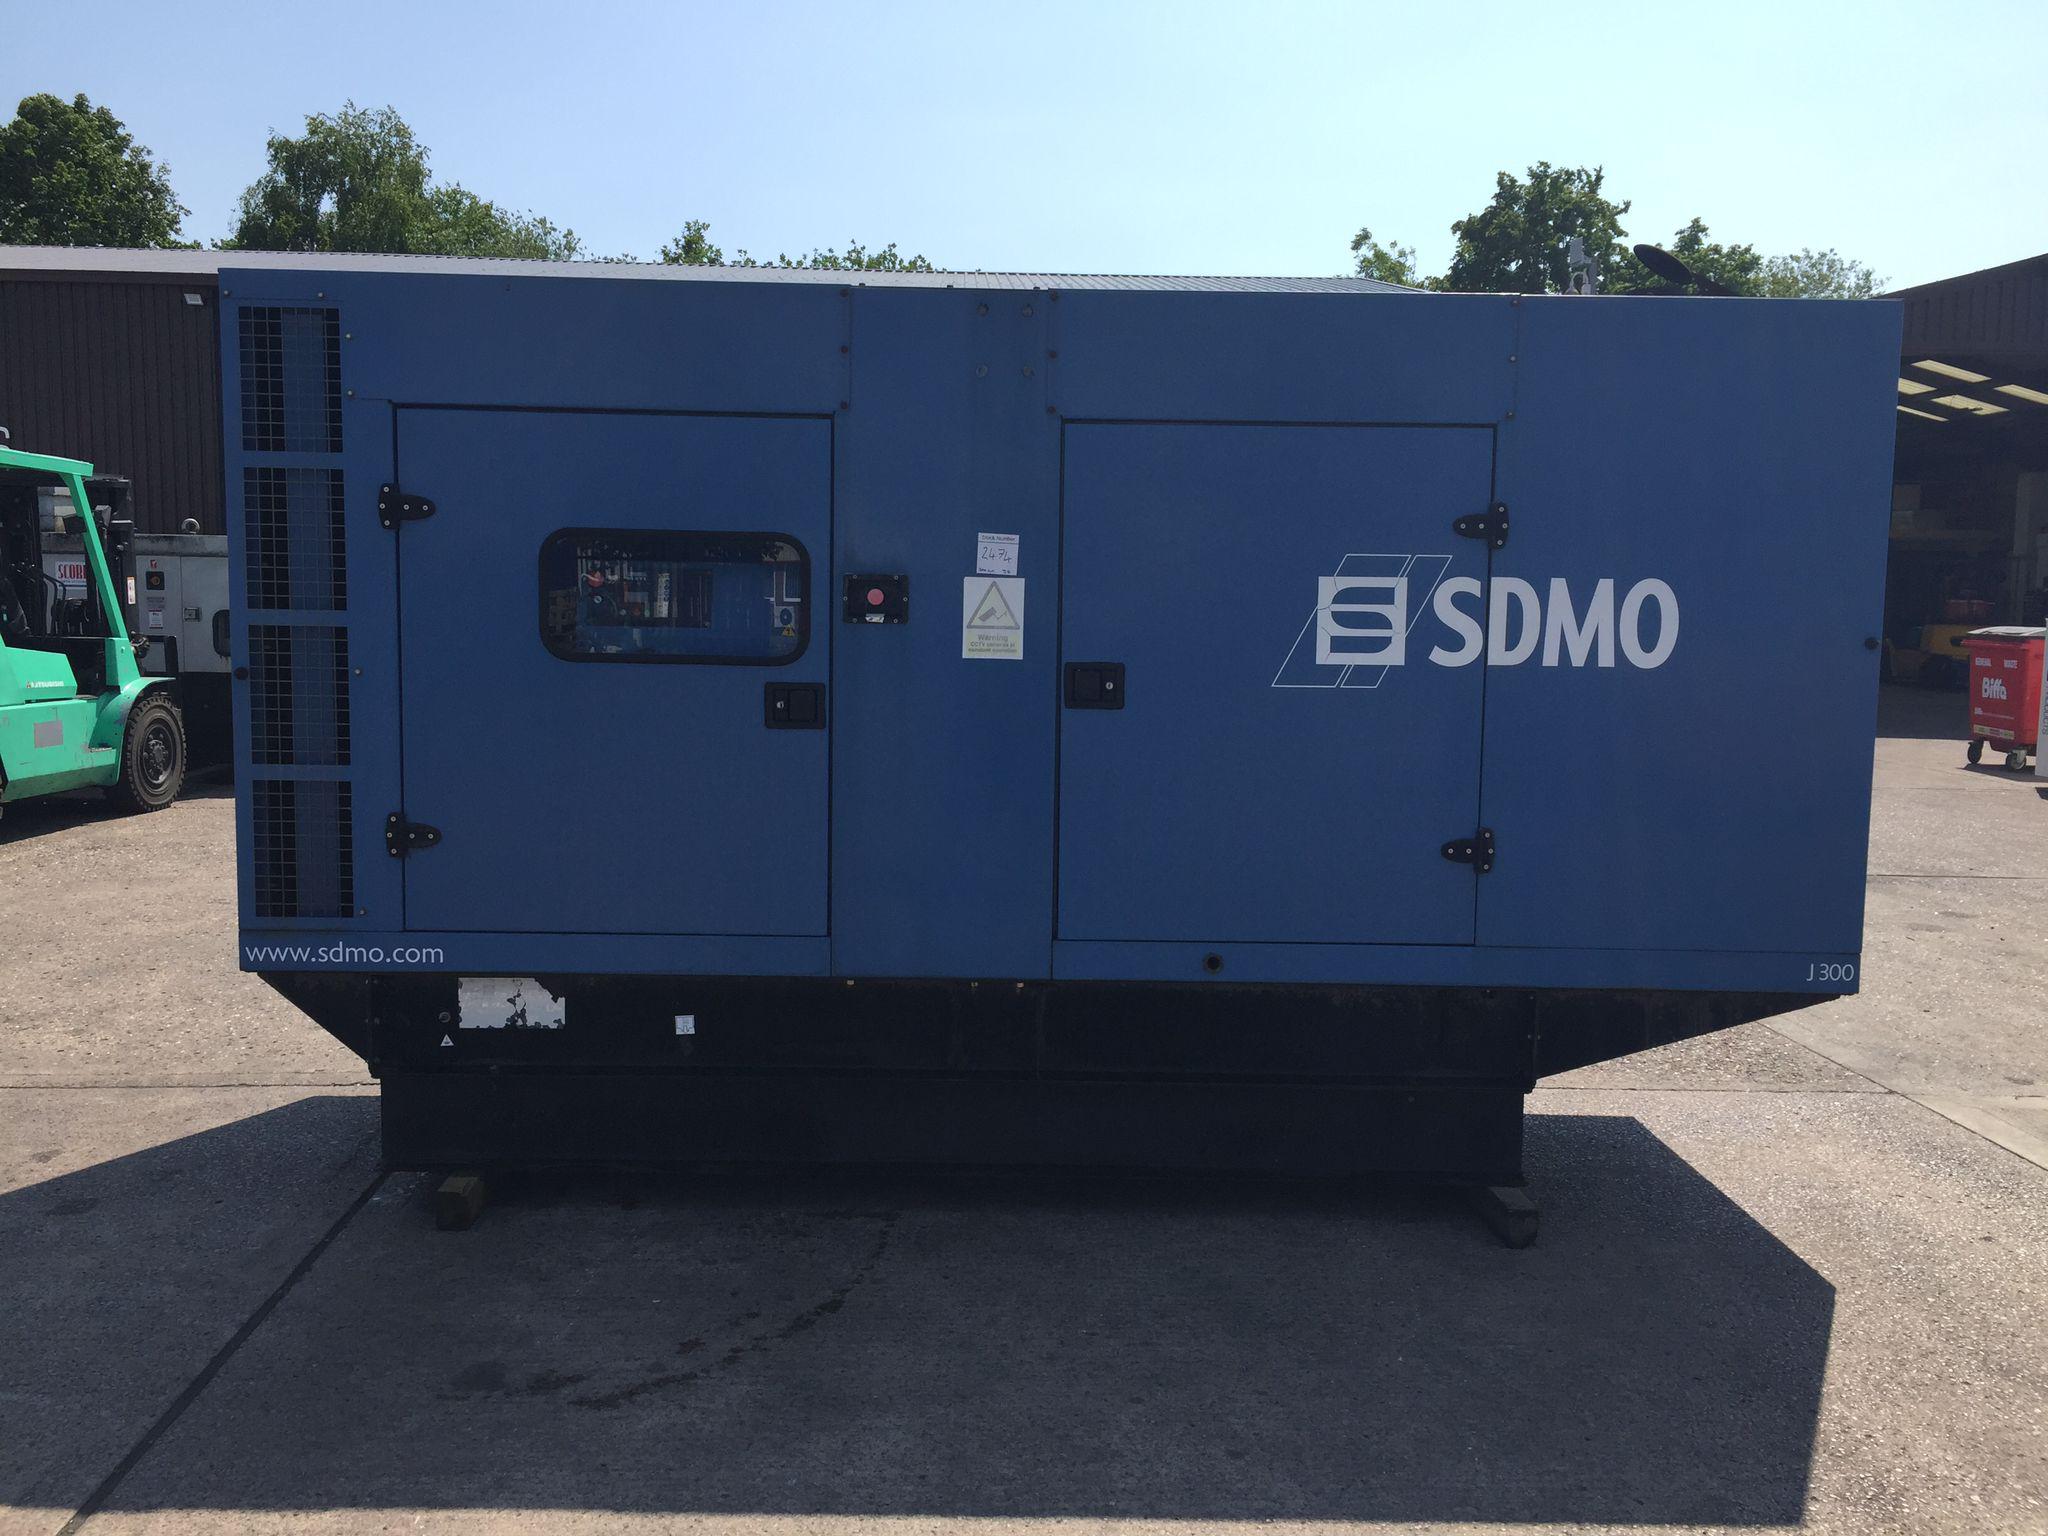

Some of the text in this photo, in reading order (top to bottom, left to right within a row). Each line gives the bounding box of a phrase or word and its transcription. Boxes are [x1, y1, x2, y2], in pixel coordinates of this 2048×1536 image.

[981, 546, 1012, 563] 2474
[1428, 576, 1679, 669] SDMO
[978, 633, 1009, 643] Warning
[1982, 677, 2008, 700] Biffa
[245, 941, 445, 963] www.sdmo.com
